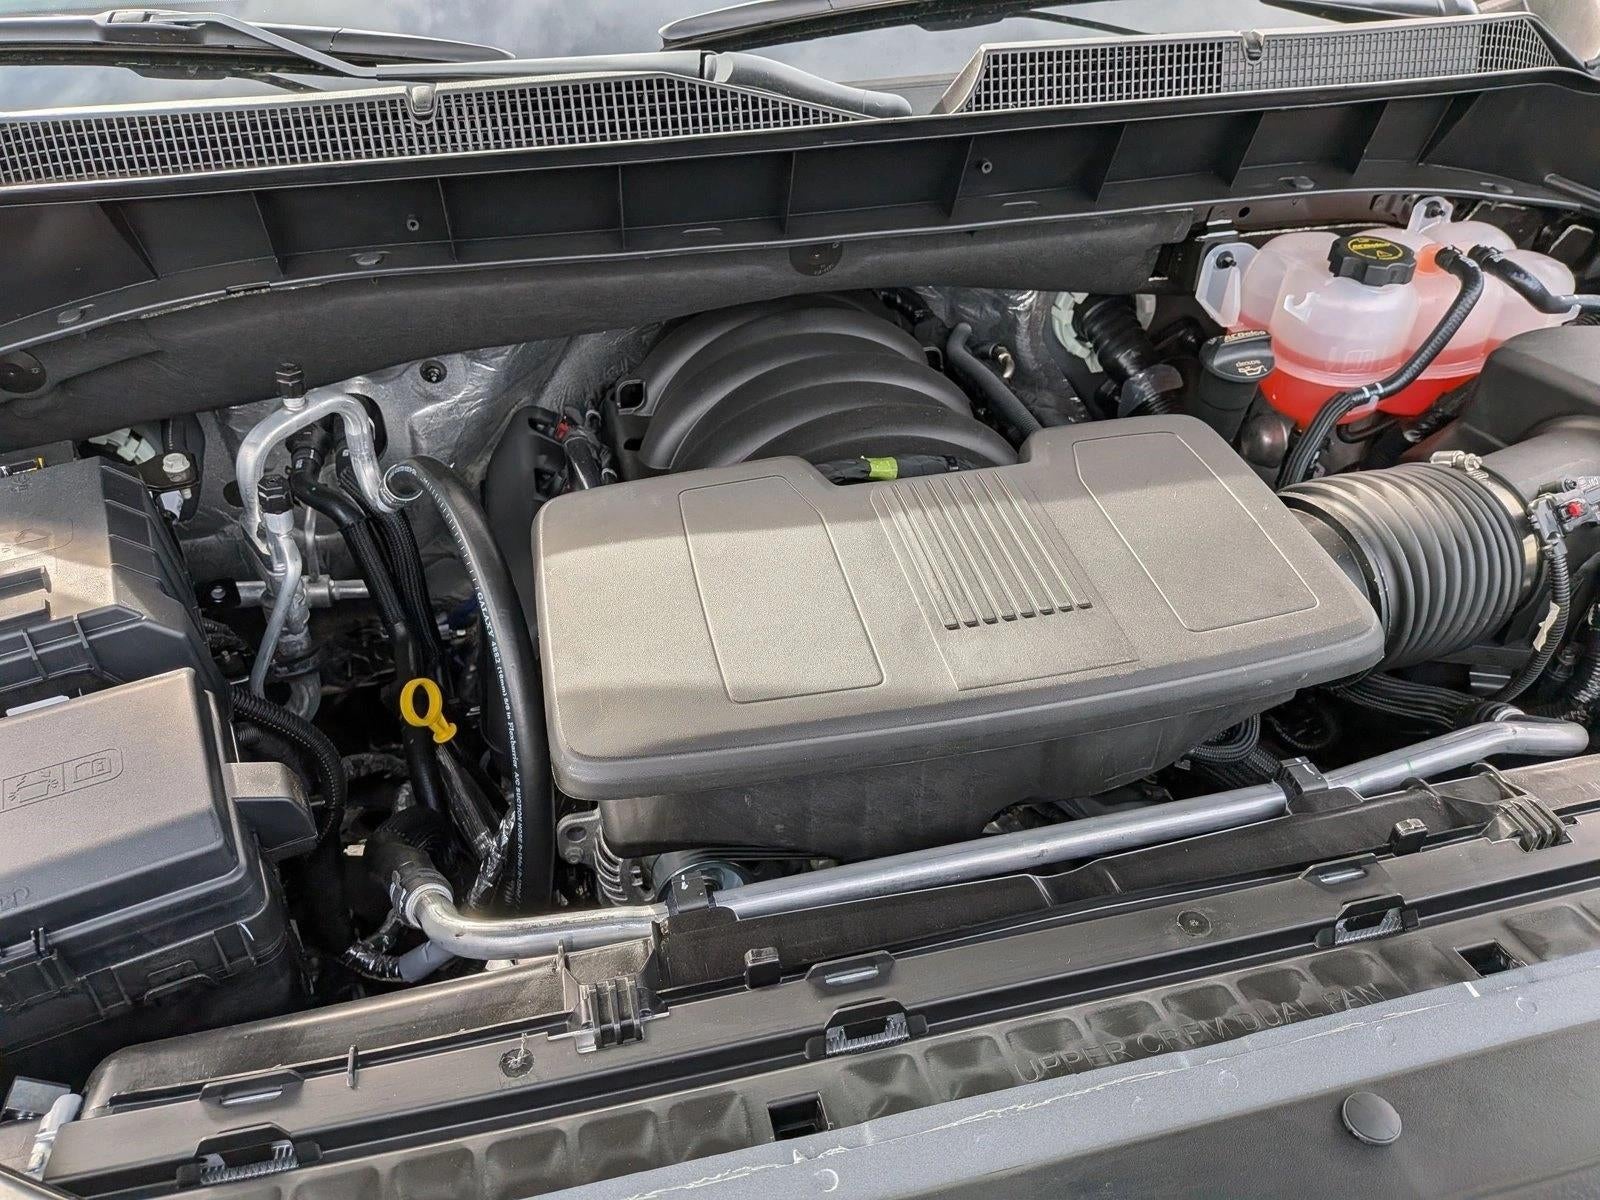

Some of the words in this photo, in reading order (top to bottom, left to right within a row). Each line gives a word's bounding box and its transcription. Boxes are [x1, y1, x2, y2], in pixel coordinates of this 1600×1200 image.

[1224, 331, 1266, 343] ACDelco
[477, 592, 495, 637] GALAXY
[508, 721, 518, 769] Flexbarrier
[515, 787, 523, 821] SUCTION
[1015, 1040, 1131, 1082] UPPER
[1241, 1000, 1322, 1031] DUAL
